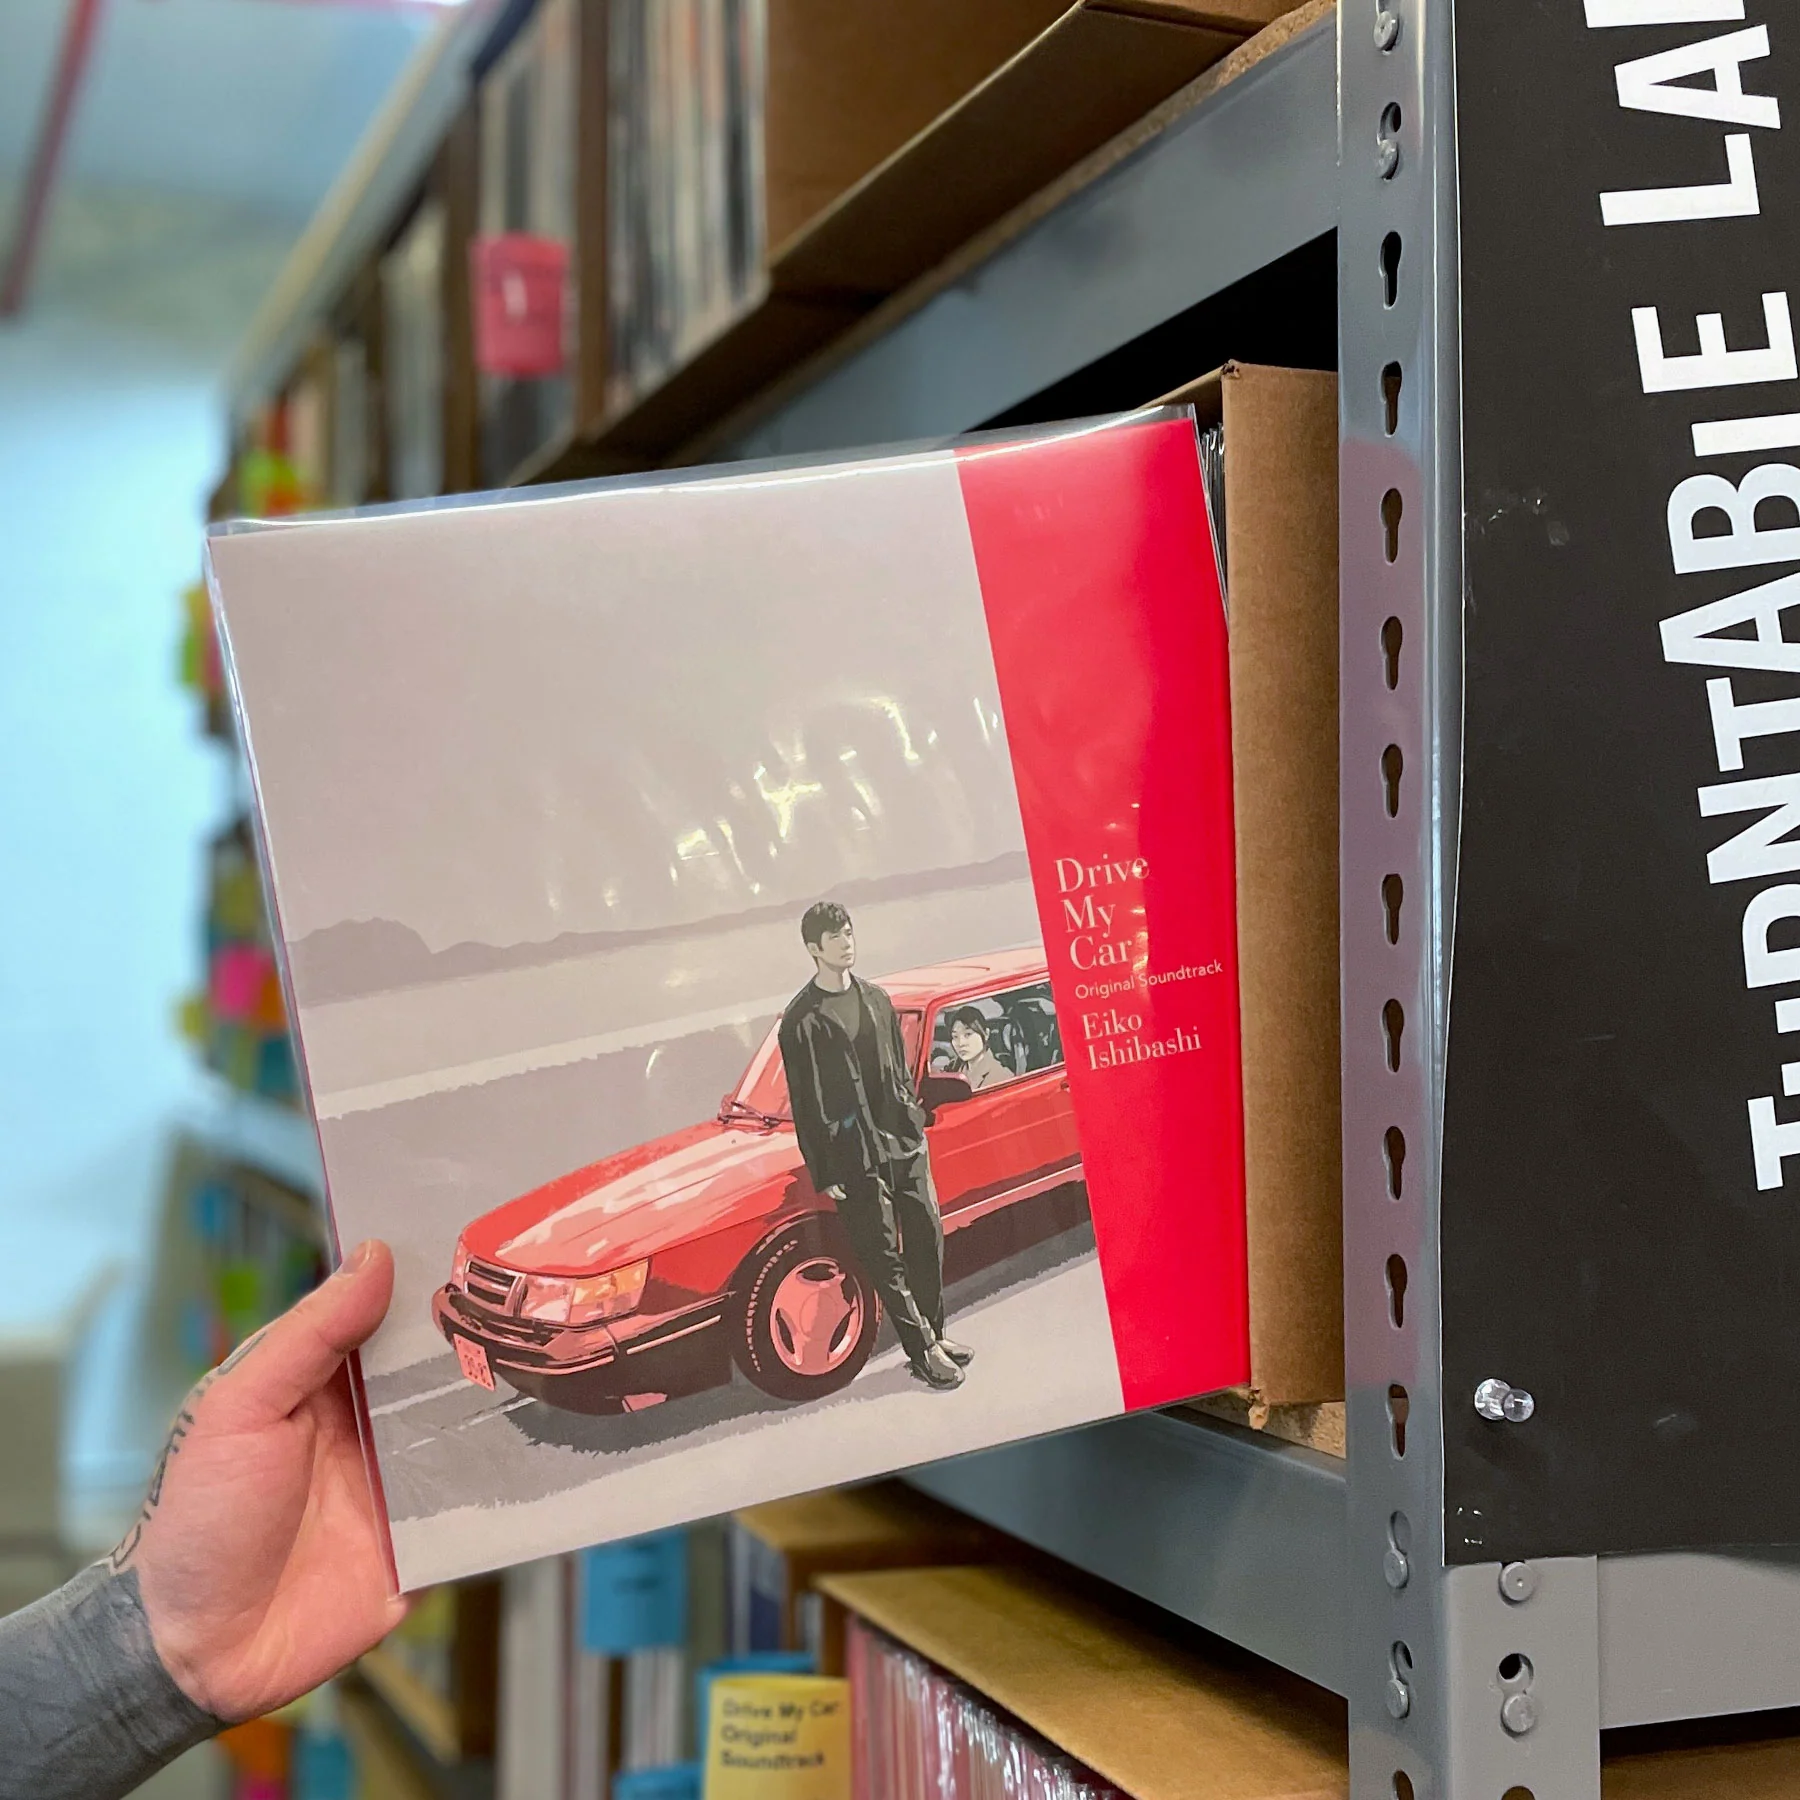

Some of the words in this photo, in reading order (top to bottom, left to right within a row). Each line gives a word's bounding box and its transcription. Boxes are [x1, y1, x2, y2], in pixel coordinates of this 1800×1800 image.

[1582, 0, 1782, 227] LA
[1630, 290, 1800, 1192] TNTABLE
[1053, 853, 1150, 893] Drive
[1061, 894, 1116, 938] My
[1069, 935, 1132, 971] Car
[1075, 976, 1136, 1000] Original
[1139, 960, 1224, 988] Soundtrack
[1082, 1009, 1142, 1040] Eiko
[1088, 1026, 1202, 1071] Ishibashi
